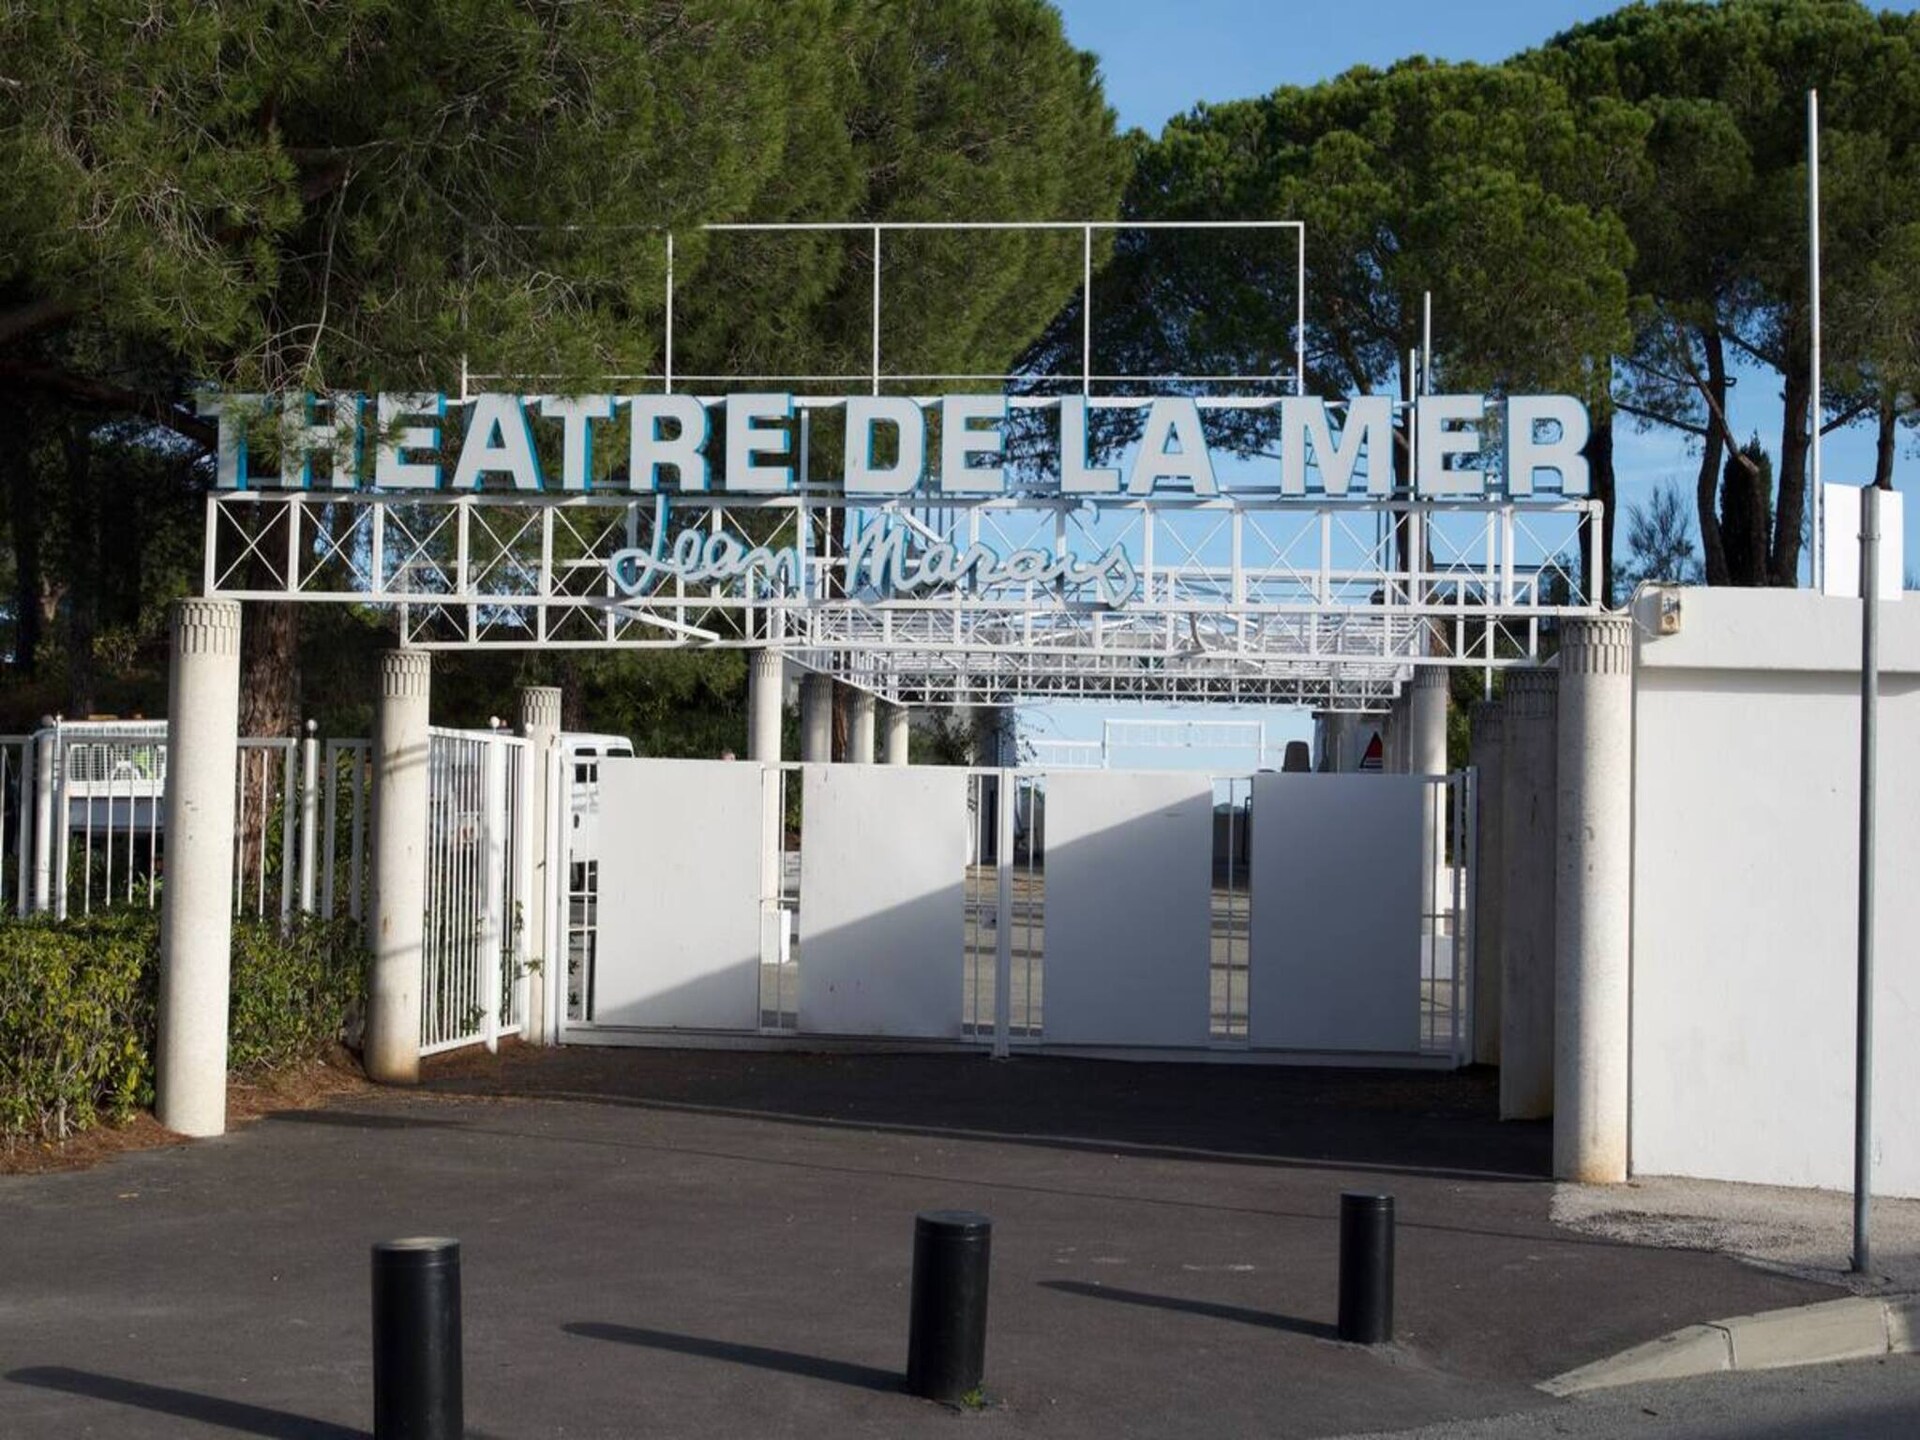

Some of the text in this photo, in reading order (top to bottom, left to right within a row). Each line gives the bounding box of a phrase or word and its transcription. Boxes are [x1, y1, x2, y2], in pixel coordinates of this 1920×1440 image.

[196, 391, 1592, 497] THEATRE DE LA MER
[608, 492, 1138, 609] Jean Marais
